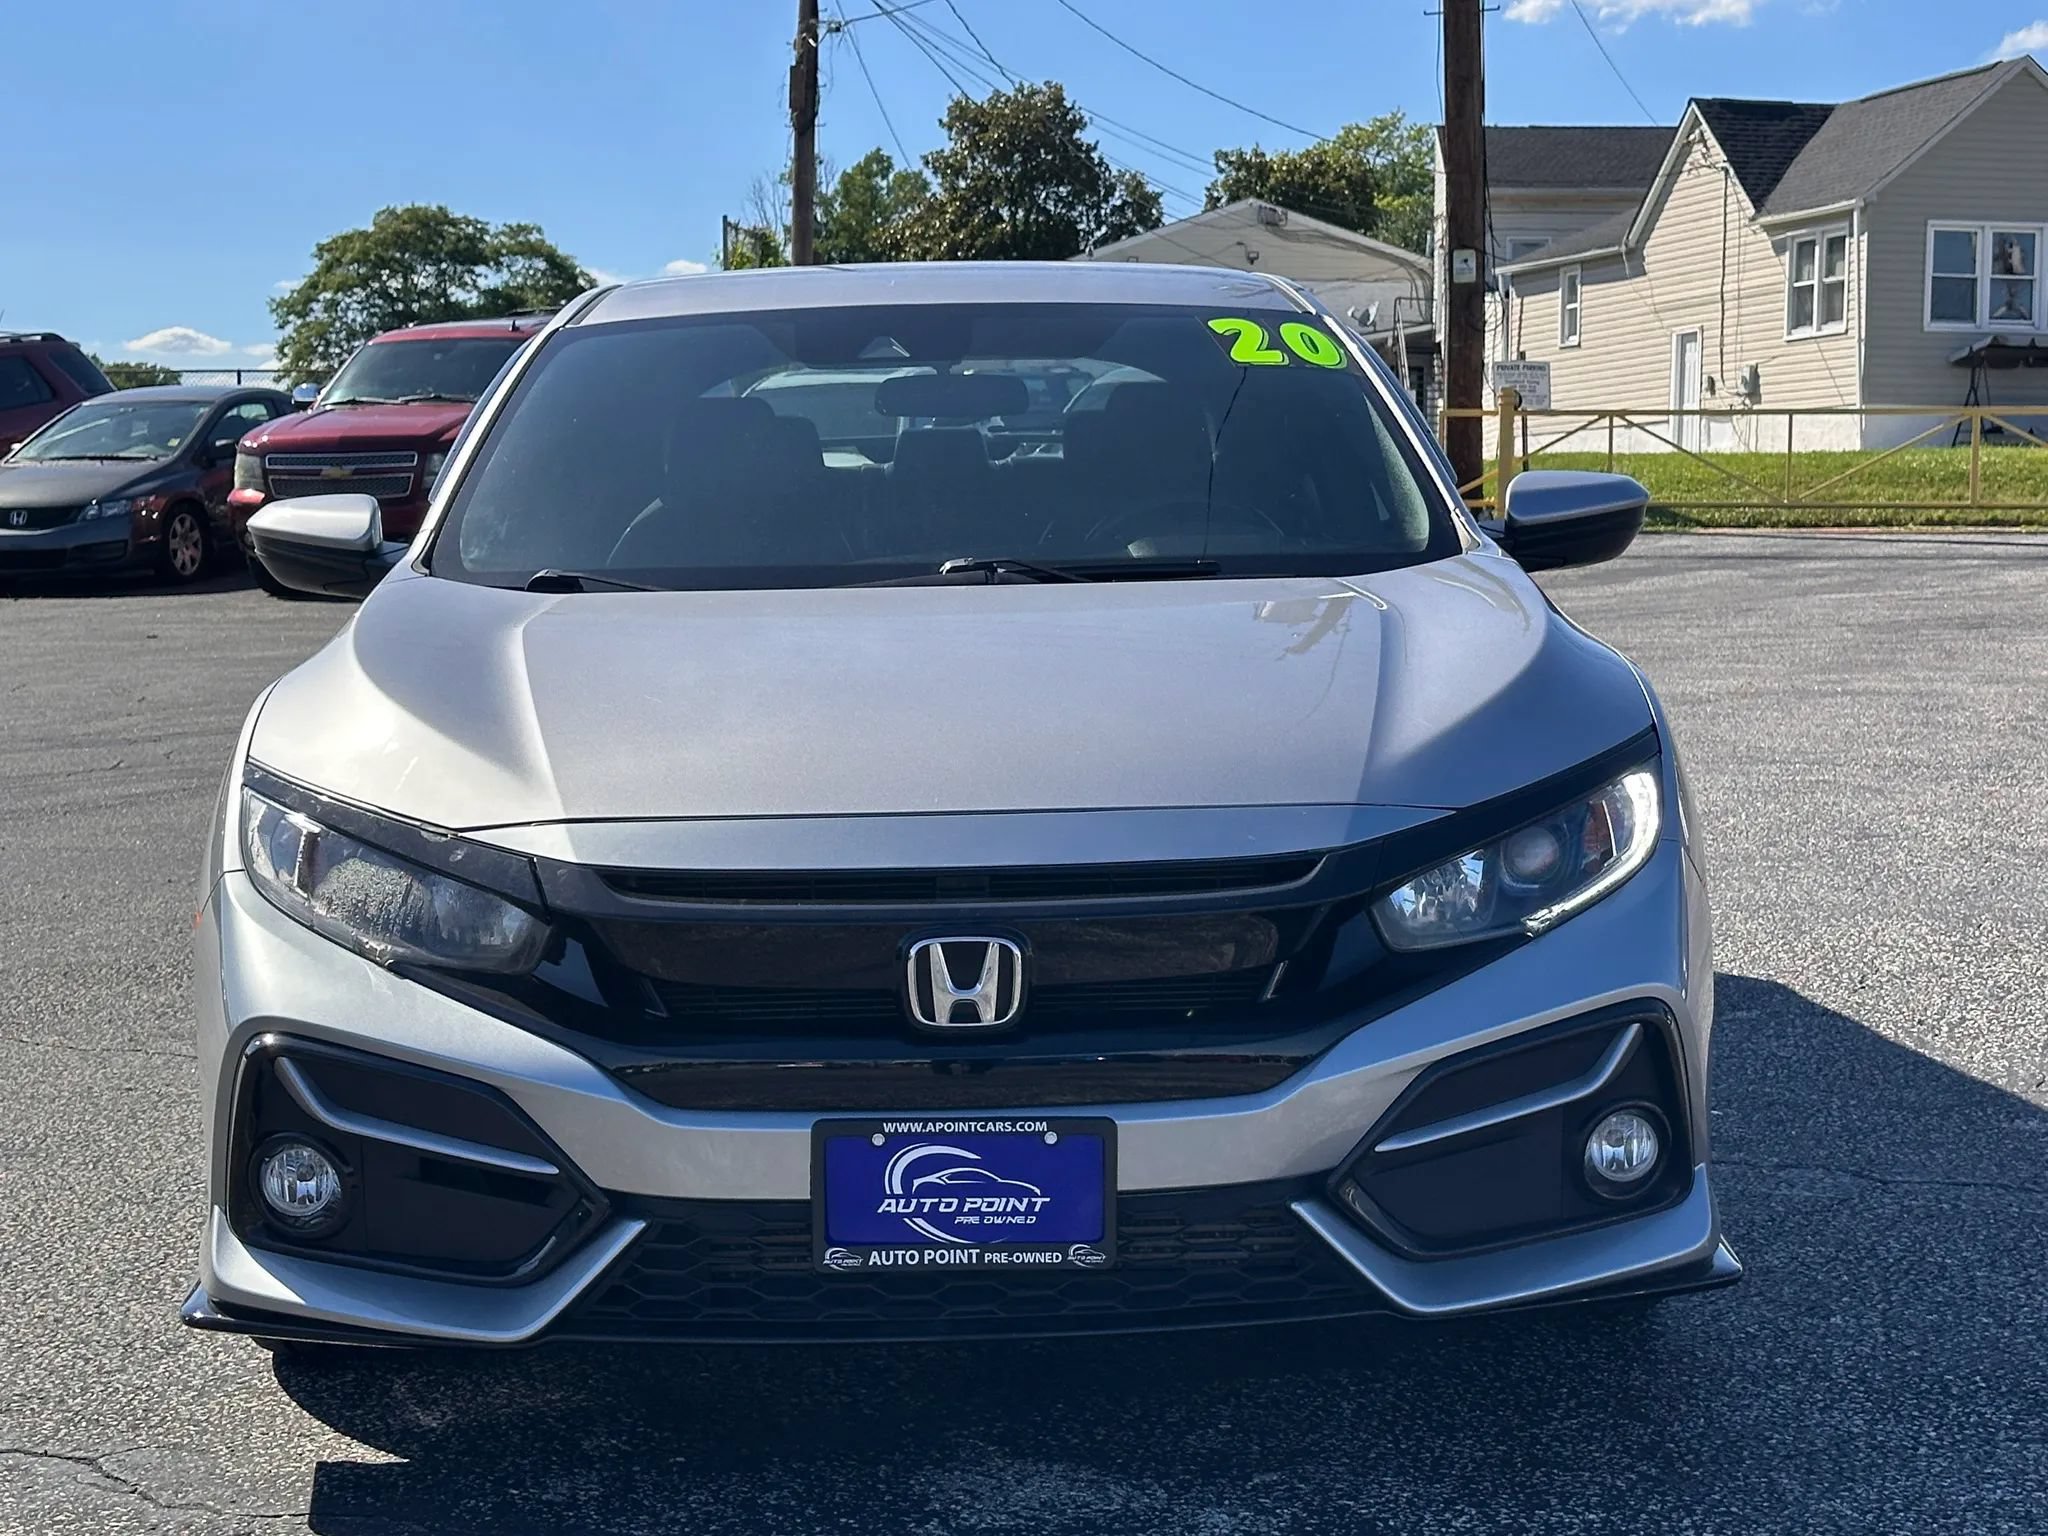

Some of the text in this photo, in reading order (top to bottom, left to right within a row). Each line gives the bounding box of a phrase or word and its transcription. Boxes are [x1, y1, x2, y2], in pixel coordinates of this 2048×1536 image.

[1207, 317, 1348, 369] 20
[883, 1121, 1048, 1133] WWW.APOINTCARS.COM
[877, 1197, 1051, 1214] AUTO POINT
[954, 1216, 1037, 1225] PRE OWNED
[868, 1248, 1062, 1266] AUTO POINT PRE-OWNED
